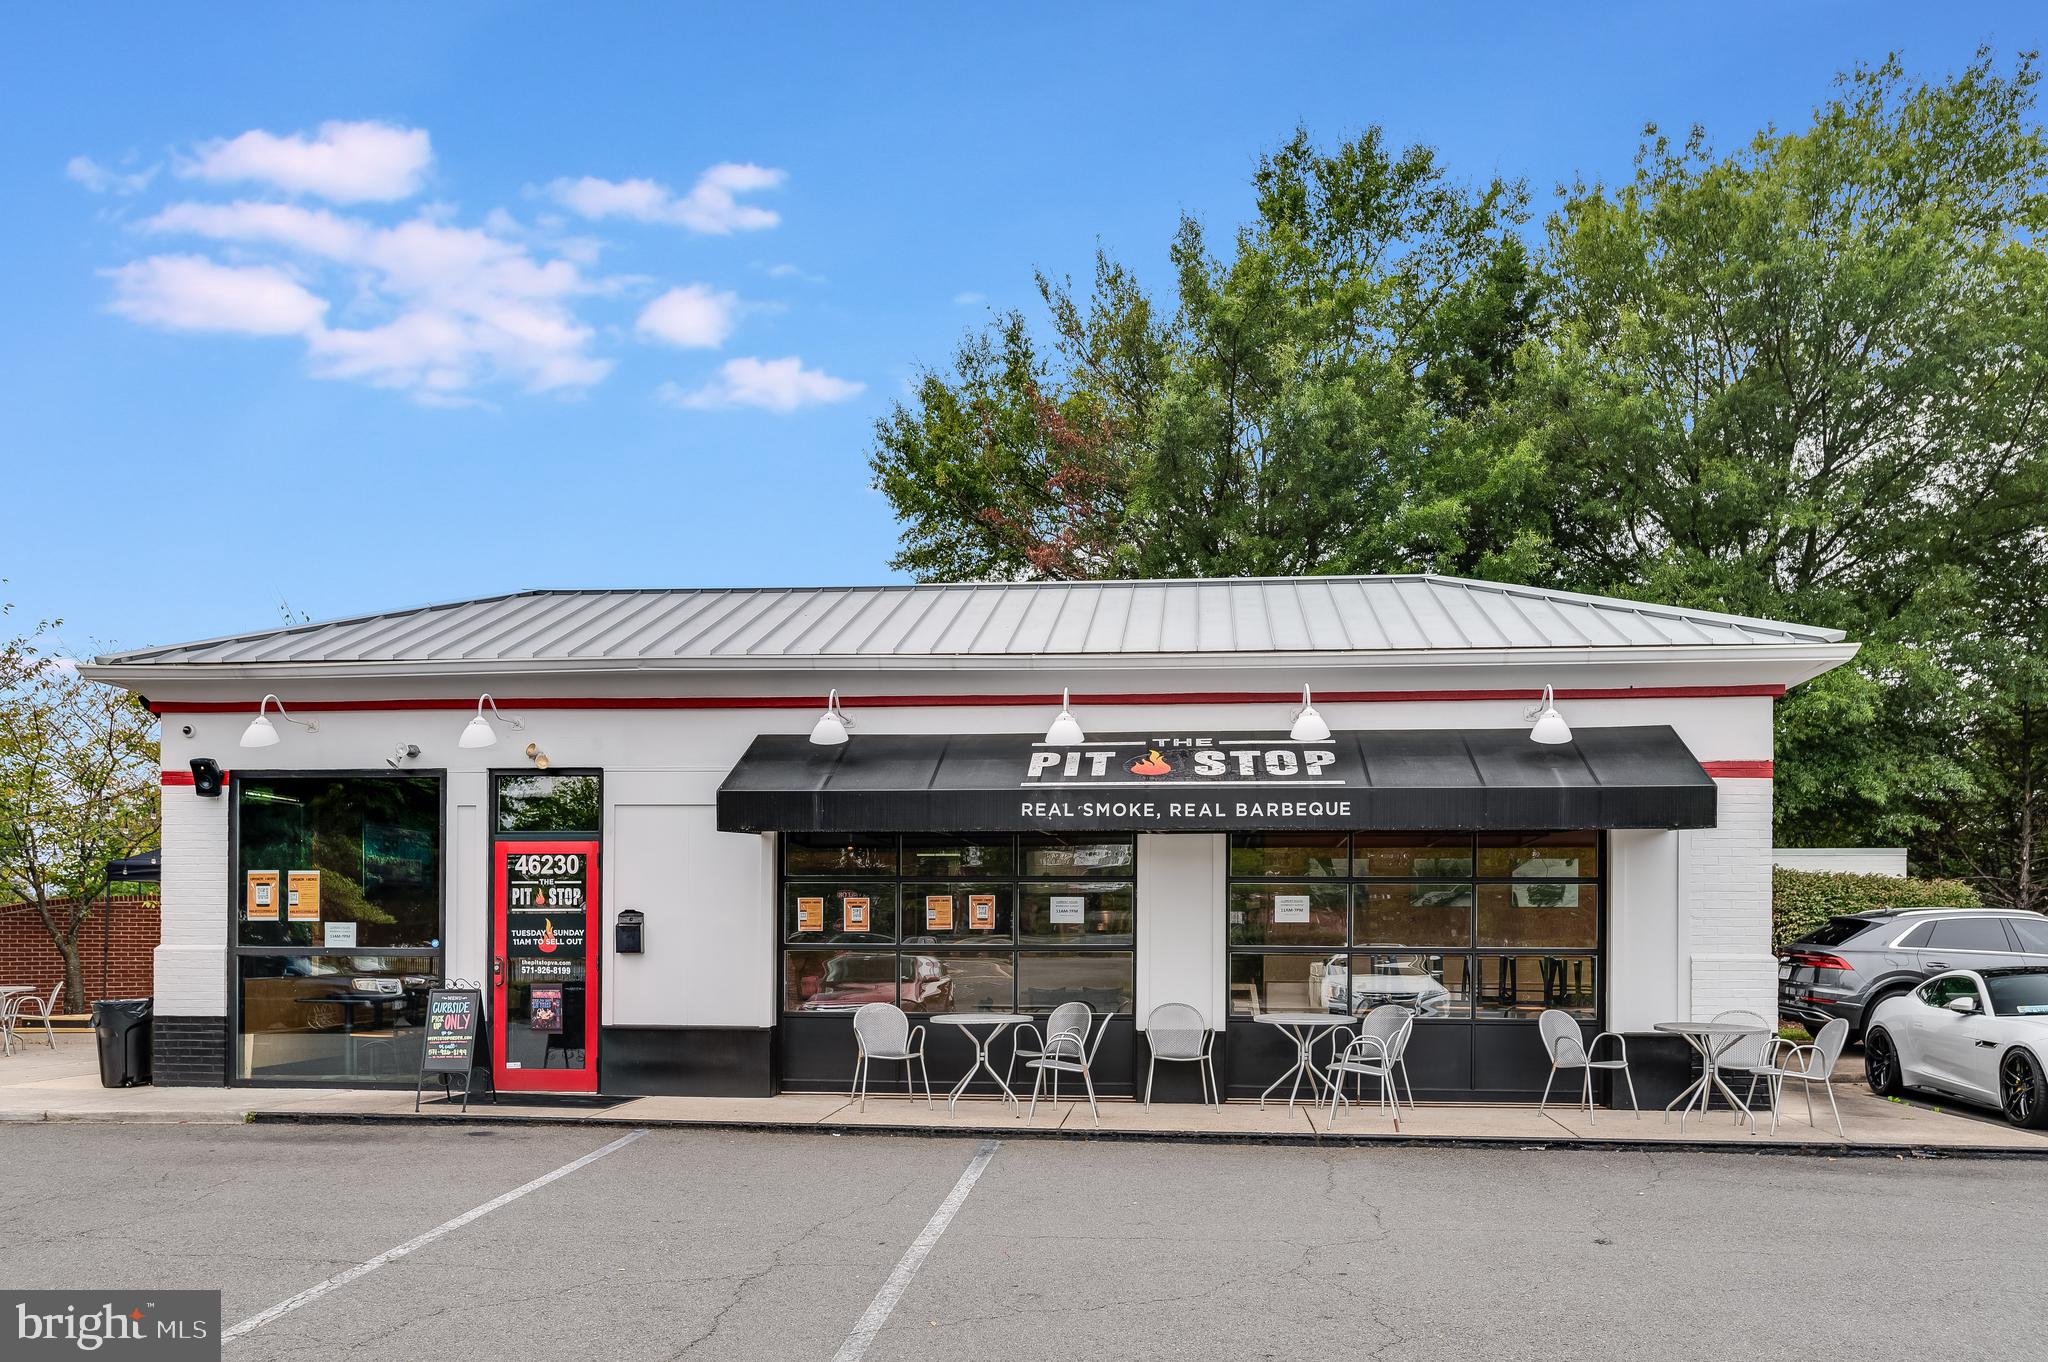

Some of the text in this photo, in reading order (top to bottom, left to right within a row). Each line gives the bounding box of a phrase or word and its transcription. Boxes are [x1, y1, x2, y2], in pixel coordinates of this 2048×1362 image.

[1152, 738, 1213, 747] THE
[1027, 750, 1336, 777] PIT STOP
[1021, 801, 1351, 819] REAL SMOKE, REAL BARBEQUE
[514, 854, 579, 875] 46230
[511, 887, 581, 905] PIT STOP
[511, 929, 546, 937] TUESDAY
[521, 966, 571, 974] 571-926-8199
[432, 1001, 470, 1013] CURBSIDE
[431, 1015, 445, 1023] PICK
[444, 1013, 471, 1030] ONLY
[433, 1022, 442, 1030] UP
